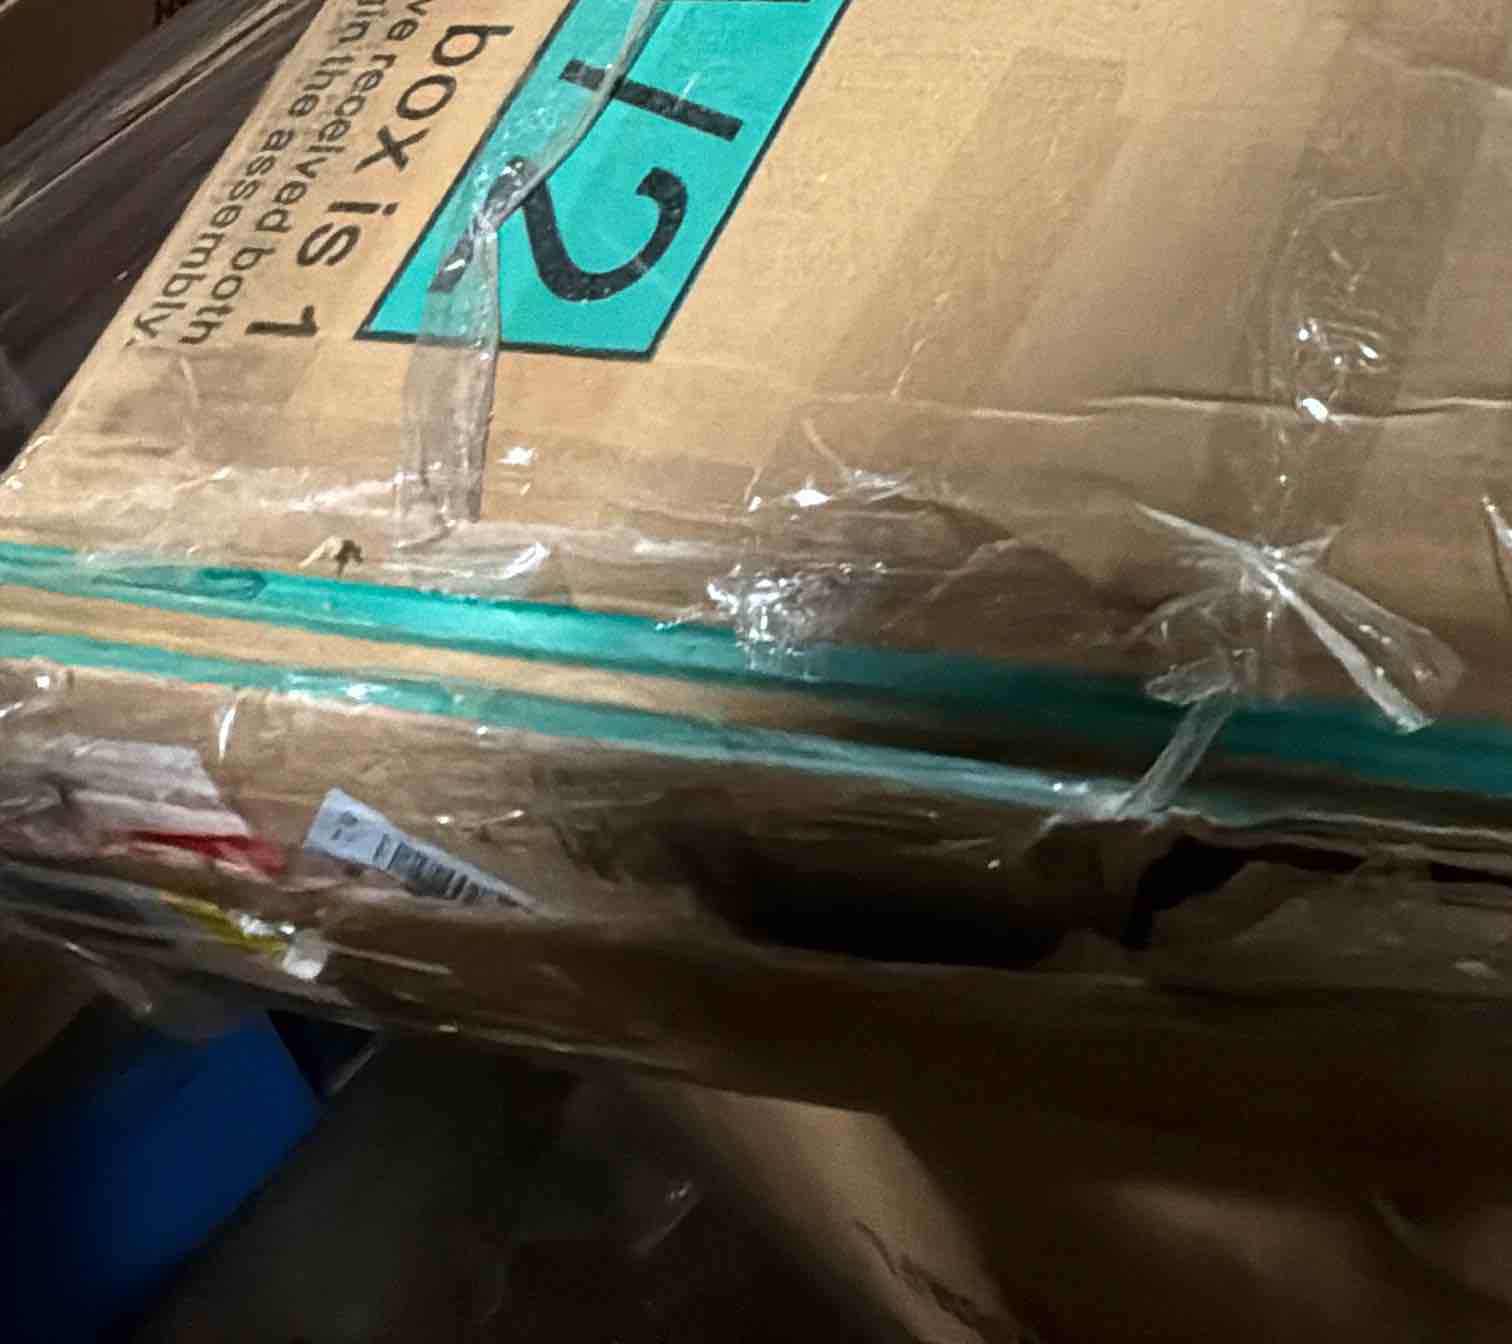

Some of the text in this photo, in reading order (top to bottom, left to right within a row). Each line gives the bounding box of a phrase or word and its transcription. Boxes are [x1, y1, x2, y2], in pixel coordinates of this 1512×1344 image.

[288, 54, 353, 115] the
[355, 25, 513, 173] box
[255, 53, 397, 234] received
[297, 201, 398, 267] is
[180, 243, 276, 345] both
[245, 305, 319, 337] 1
